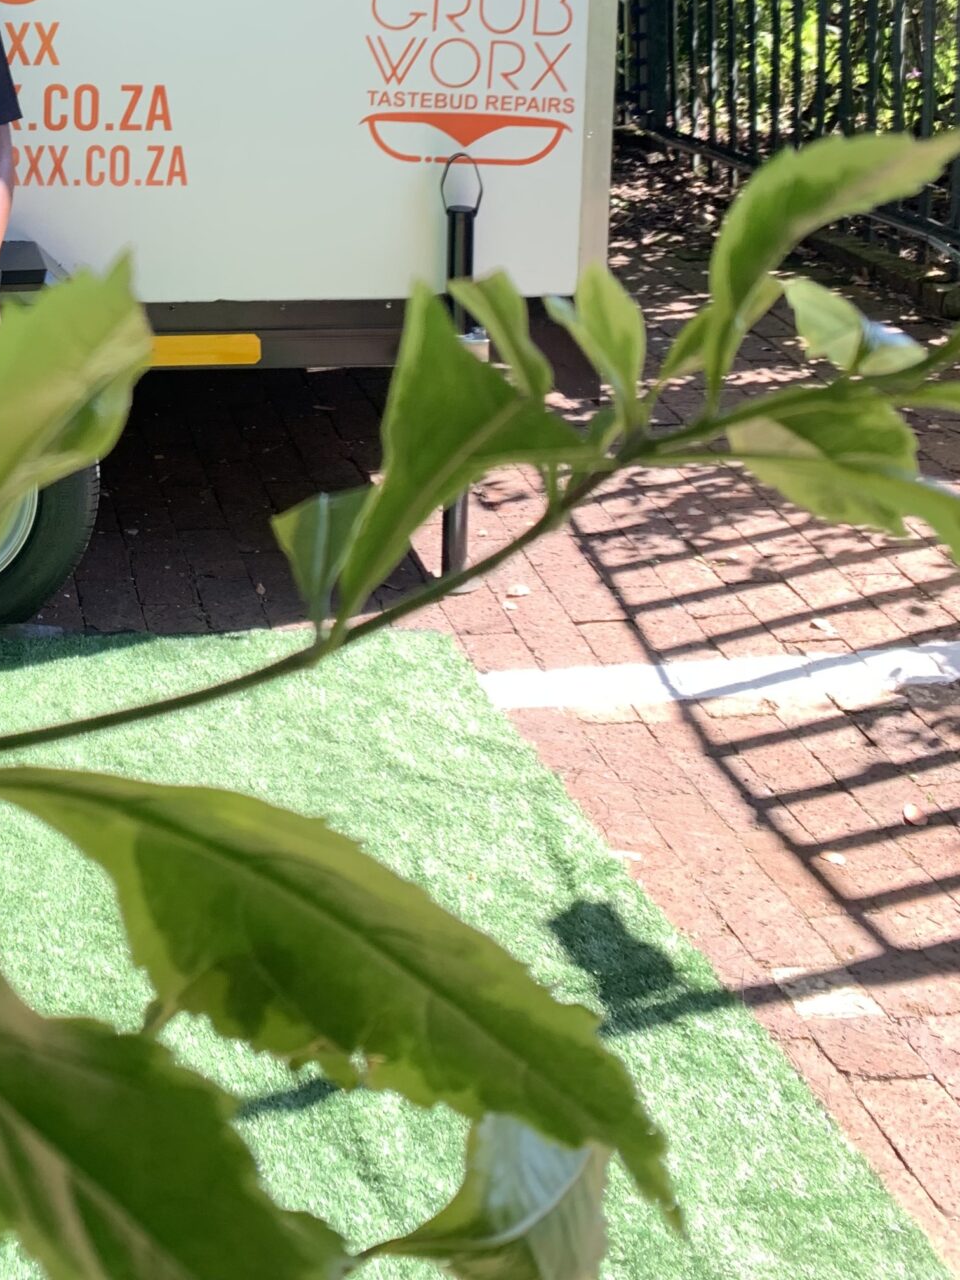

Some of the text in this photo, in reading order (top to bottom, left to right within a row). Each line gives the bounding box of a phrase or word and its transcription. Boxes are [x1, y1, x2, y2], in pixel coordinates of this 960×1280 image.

[365, 35, 572, 93] WORX
[367, 90, 575, 113] TASTEBUD REPAIRS
